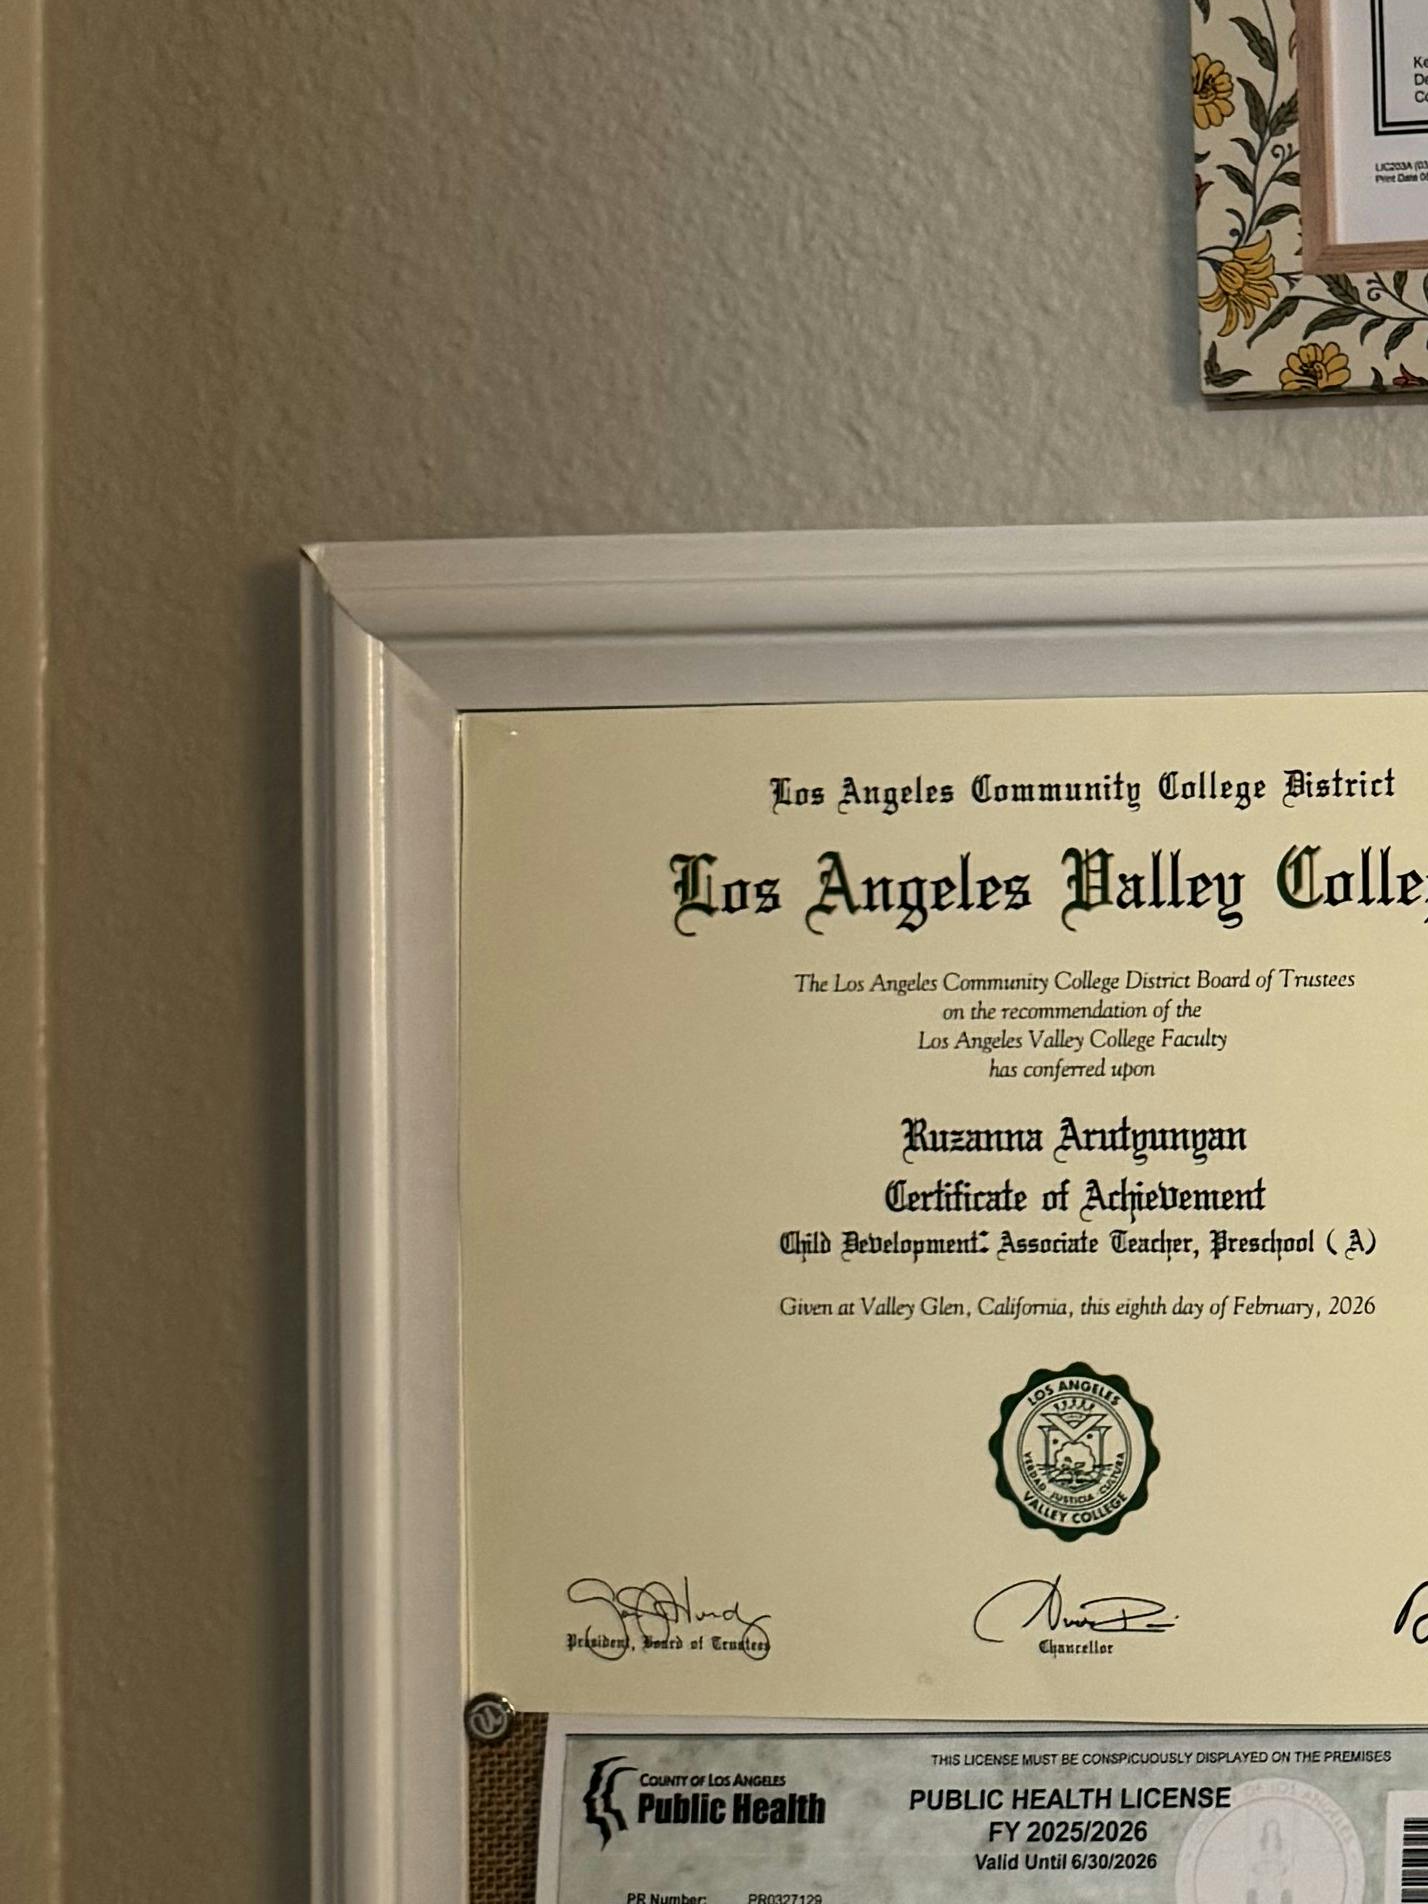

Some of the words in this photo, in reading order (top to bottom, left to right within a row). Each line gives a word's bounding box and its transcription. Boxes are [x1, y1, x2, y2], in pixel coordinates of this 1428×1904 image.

[768, 775, 825, 816] Los
[836, 774, 954, 816] Angeles
[970, 770, 1141, 812] Community
[1157, 769, 1266, 811] College
[1281, 766, 1396, 809] District
[667, 851, 782, 938] Los
[803, 849, 1033, 936] Angeles
[1060, 846, 1246, 932] Valley
[883, 1177, 1028, 1213] Certificate
[1040, 1177, 1071, 1212] of
[1078, 1175, 1267, 1222] Achievement
[1028, 1384, 1055, 1406] LOS
[1059, 1379, 1122, 1406] ANGELES
[1023, 1489, 1067, 1523] VALLEY
[1072, 1491, 1128, 1524] COLLEGE
[1037, 1638, 1114, 1659] Chancellor
[638, 1771, 689, 1788] COUNTY
[688, 1774, 707, 1788] OF
[706, 1772, 732, 1788] LOS
[731, 1772, 787, 1788] ANGELES
[636, 1791, 727, 1825] Public
[731, 1791, 826, 1825] Health
[908, 1787, 1004, 1811] PUBLIC
[1010, 1786, 1113, 1810] HEALTH
[1119, 1785, 1232, 1810] LICENSE
[987, 1819, 1021, 1843] FY
[1025, 1819, 1148, 1843] 2025/2026
[973, 1852, 1019, 1871] Valid
[1023, 1852, 1068, 1871] Until
[1070, 1851, 1158, 1870] 6/30/2026
